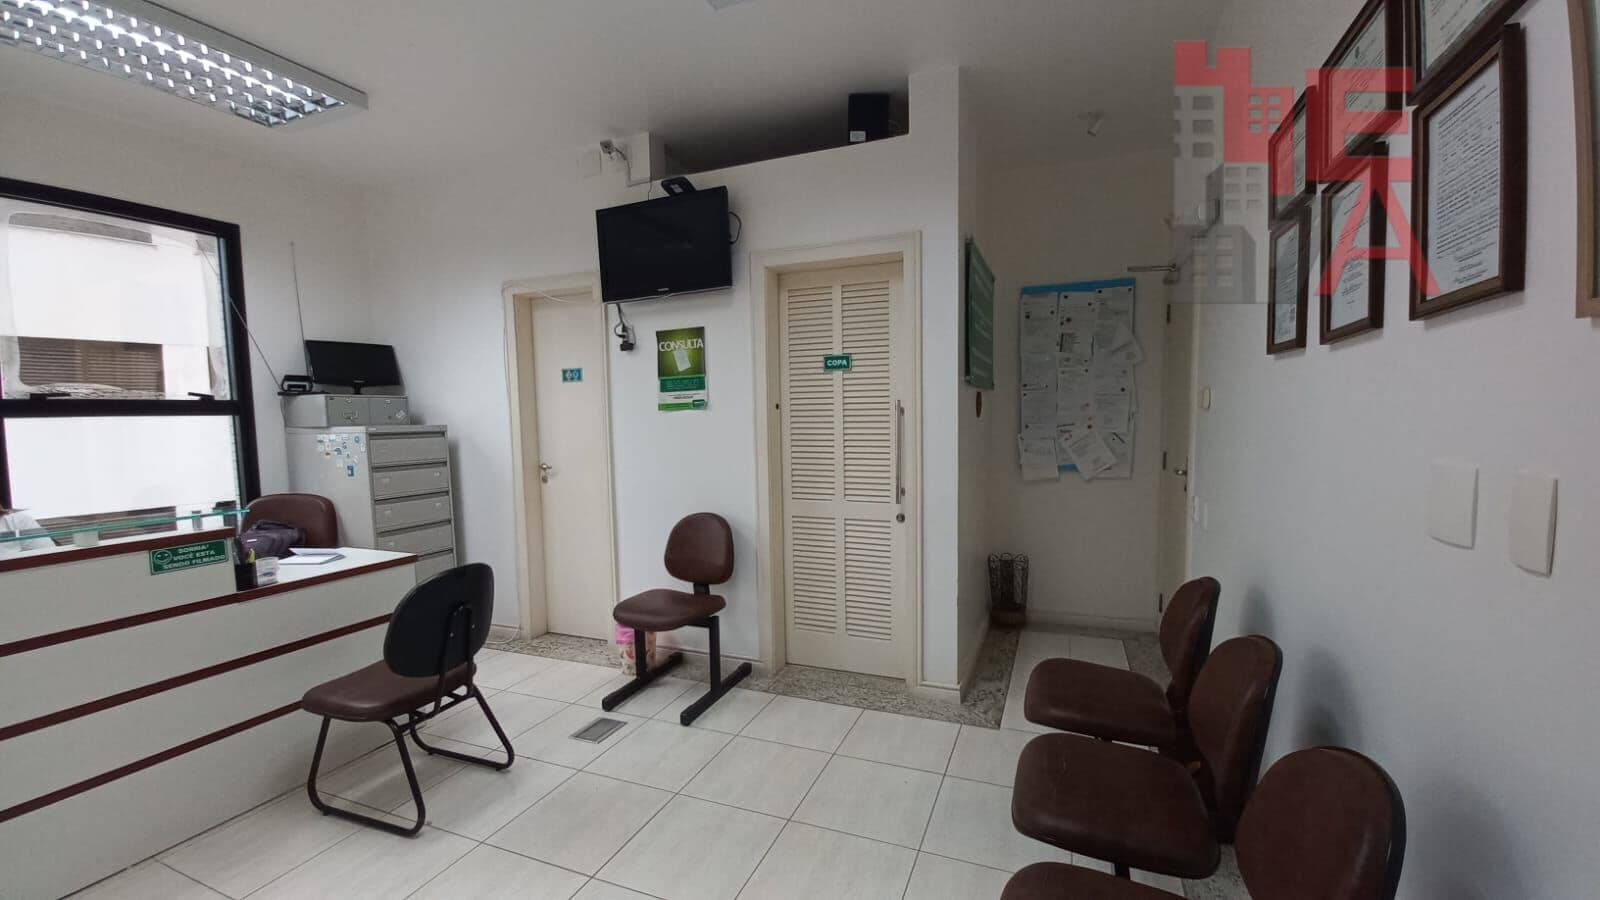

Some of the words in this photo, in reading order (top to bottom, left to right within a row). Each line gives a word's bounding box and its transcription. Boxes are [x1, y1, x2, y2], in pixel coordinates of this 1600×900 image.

[658, 338, 704, 352] CONSULTA
[826, 359, 848, 367] COPA
[163, 560, 190, 570] SENDO
[192, 554, 226, 565] FILMADO
